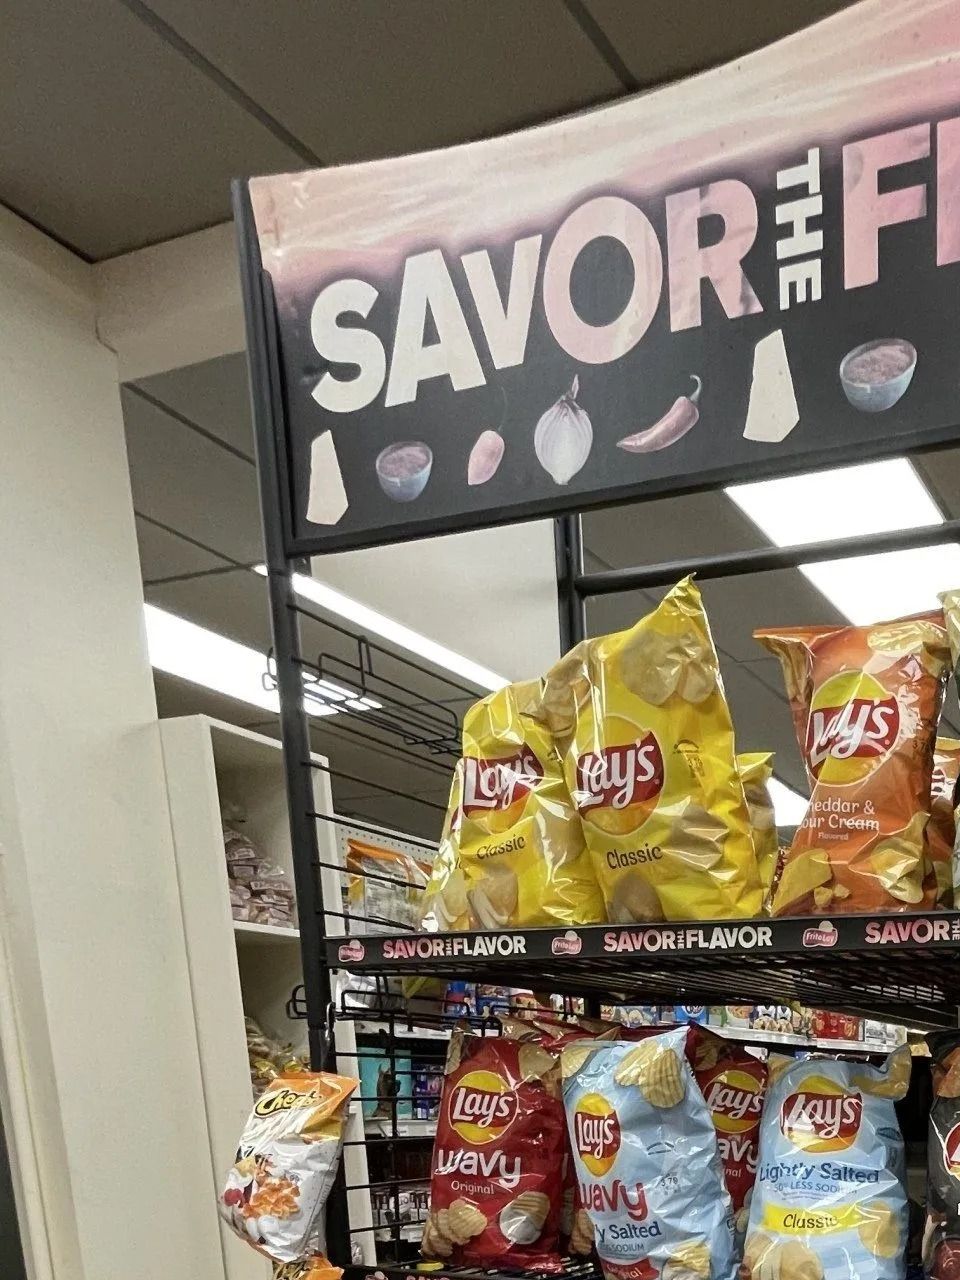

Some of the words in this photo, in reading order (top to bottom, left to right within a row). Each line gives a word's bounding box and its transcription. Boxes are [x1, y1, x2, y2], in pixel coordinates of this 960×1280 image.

[310, 178, 763, 413] SAVOR
[776, 147, 823, 311] THE
[811, 700, 894, 767] Lay's
[463, 753, 535, 811] Lay's
[577, 738, 655, 810] Lay's
[863, 800, 876, 815] &
[828, 814, 880, 831] Cream
[476, 834, 526, 861] Classic
[606, 843, 664, 870] Classic
[604, 929, 677, 952] SAVOR
[686, 925, 773, 950] FLAVOR
[864, 919, 950, 944] SAVOR
[383, 938, 445, 960] SAVOR
[453, 935, 526, 957] FLAVOR
[452, 1087, 513, 1128] Lay's
[707, 1083, 764, 1119] Lay's
[785, 1094, 857, 1139] Lay's
[577, 1110, 615, 1159] Lay's
[759, 1162, 815, 1184] Lightly
[820, 1163, 880, 1184] Salted
[790, 1181, 812, 1191] LESS
[451, 1180, 495, 1196] Original
[609, 1221, 662, 1241] Salted
[783, 1213, 838, 1229] Classic
